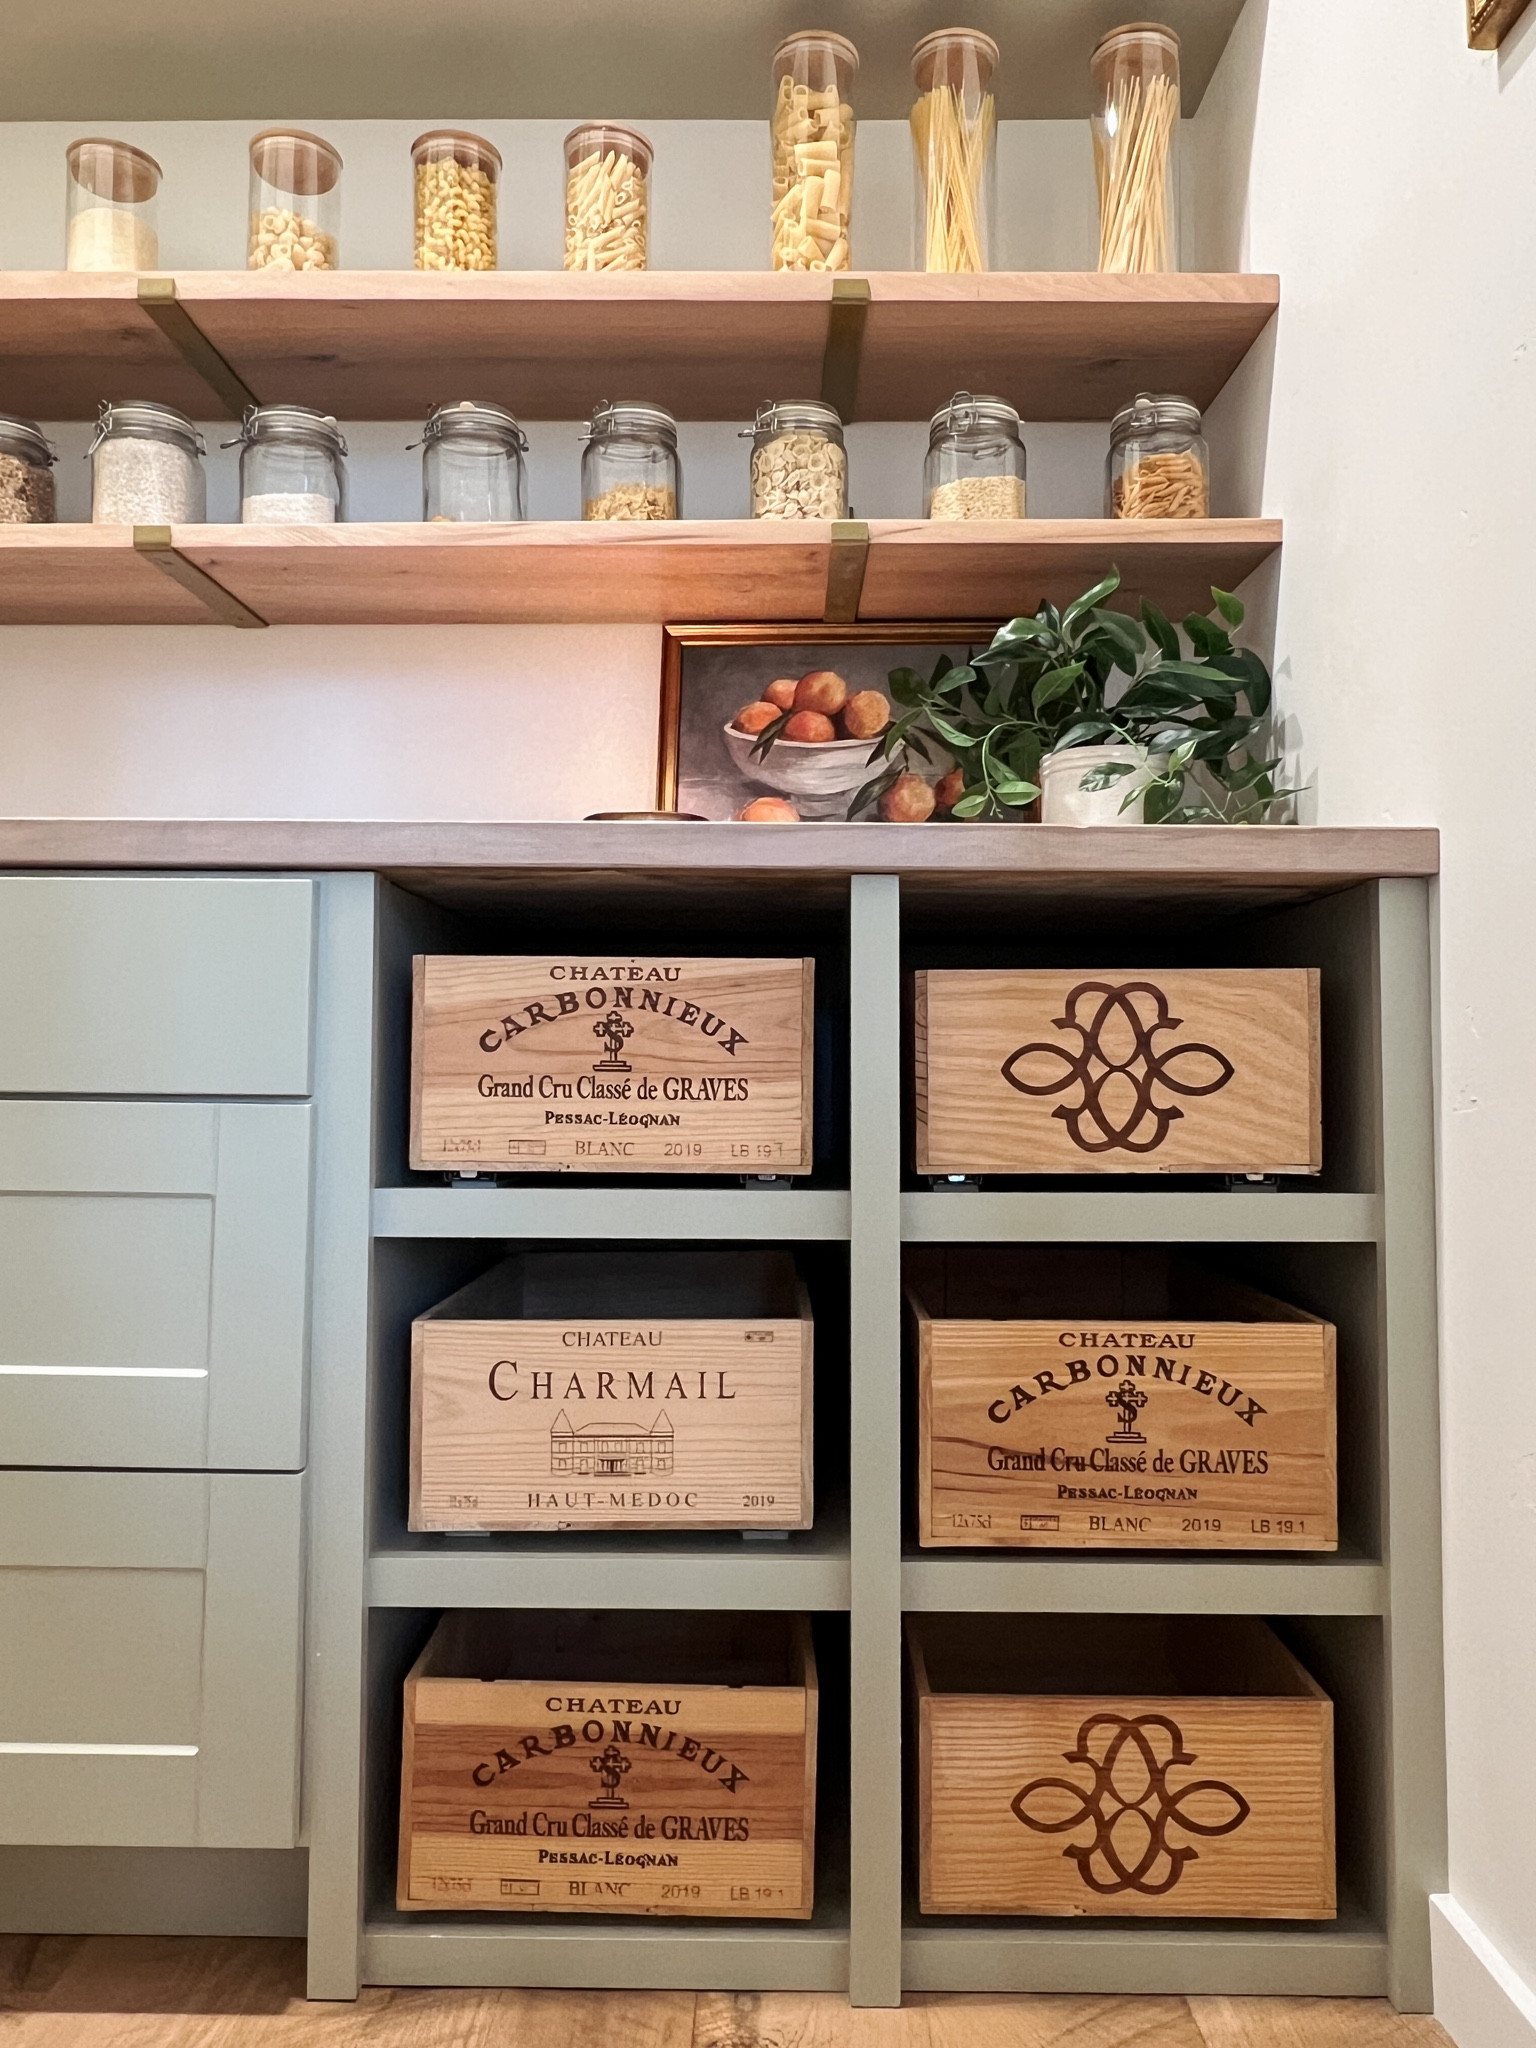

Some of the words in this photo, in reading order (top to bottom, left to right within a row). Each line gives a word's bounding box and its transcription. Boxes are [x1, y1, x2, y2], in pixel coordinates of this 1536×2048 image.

[549, 965, 682, 981] CHATEAU
[478, 986, 750, 1056] CARBONNIEUX
[477, 1073, 534, 1099] Grand
[539, 1075, 573, 1099] Cru
[577, 1075, 632, 1100] Classé
[637, 1076, 658, 1100] de
[663, 1077, 749, 1101] GRAVES
[575, 1140, 636, 1157] BLANC
[663, 1142, 702, 1157] 2019
[562, 1331, 663, 1347] CHATEAU
[1058, 1332, 1196, 1349] CHATEAU
[488, 1360, 736, 1402] CHARMAIL
[987, 1354, 1268, 1428] CARBONNIEUX
[987, 1446, 1046, 1472] Grand
[1050, 1447, 1086, 1472] Cru
[1090, 1447, 1147, 1474] Classé
[1152, 1448, 1175, 1474] de
[1179, 1448, 1269, 1475] GRAVES
[527, 1491, 699, 1508] HAUT-MEDOC
[743, 1495, 775, 1508] 2019
[1088, 1515, 1152, 1532] BLANC
[1181, 1518, 1222, 1532] 2019
[1250, 1519, 1271, 1533] LB
[545, 1697, 682, 1715] CHATEAU
[471, 1719, 750, 1794] CARBONNIEUX
[469, 1809, 528, 1837] Grand
[532, 1812, 568, 1837] Cru
[571, 1812, 629, 1839] Classé
[634, 1814, 656, 1840] de
[661, 1815, 750, 1841] GRAVES
[661, 1884, 701, 1899] 2019
